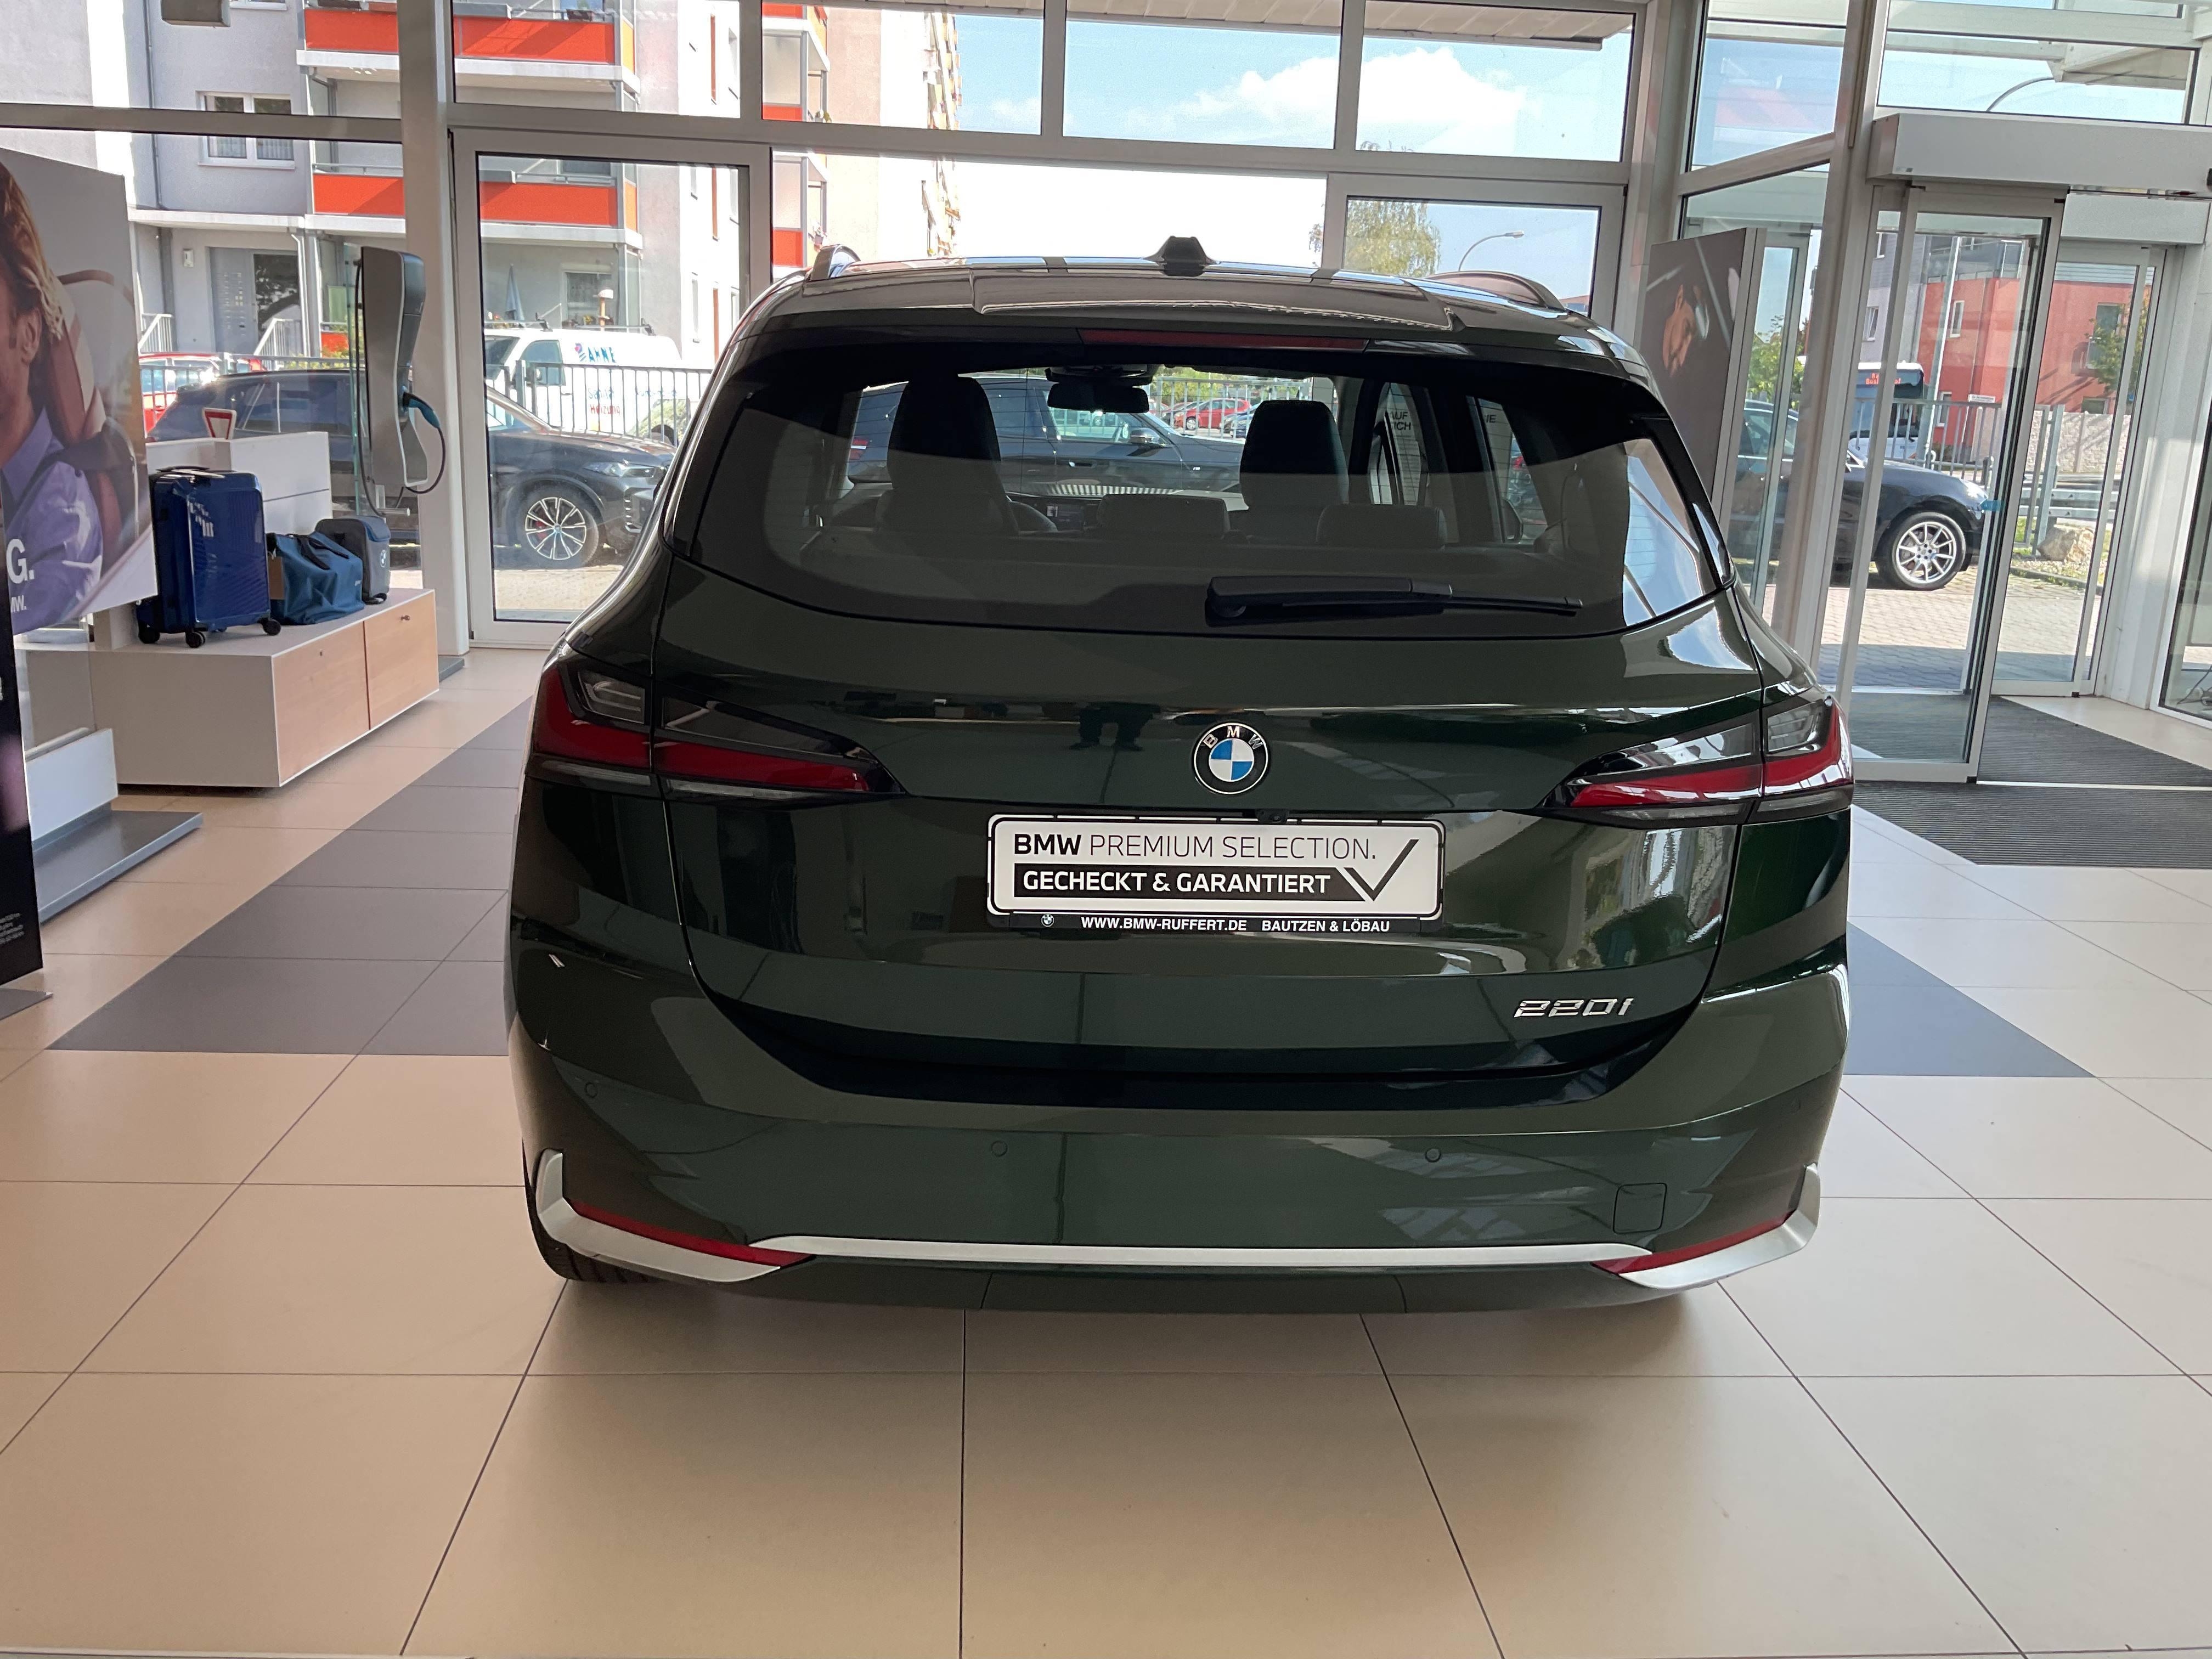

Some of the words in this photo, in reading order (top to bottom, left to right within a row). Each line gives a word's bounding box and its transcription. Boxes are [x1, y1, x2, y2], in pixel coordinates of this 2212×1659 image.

[1203, 726, 1263, 749] BMW
[1015, 833, 1081, 855] BMW
[1090, 834, 1213, 857] PREMIUM
[1222, 836, 1375, 860] SELECTION.
[1023, 870, 1147, 891] GECHECKT
[1152, 872, 1171, 892] &
[1176, 872, 1330, 893] GARANTIERT
[1081, 917, 1247, 931] WWW.BMW-RUFFERT.DE
[1262, 919, 1325, 932] BAUTZEN
[1329, 921, 1339, 932] &
[1342, 918, 1390, 932] LÖBAU
[1514, 998, 1634, 1018] 220i
